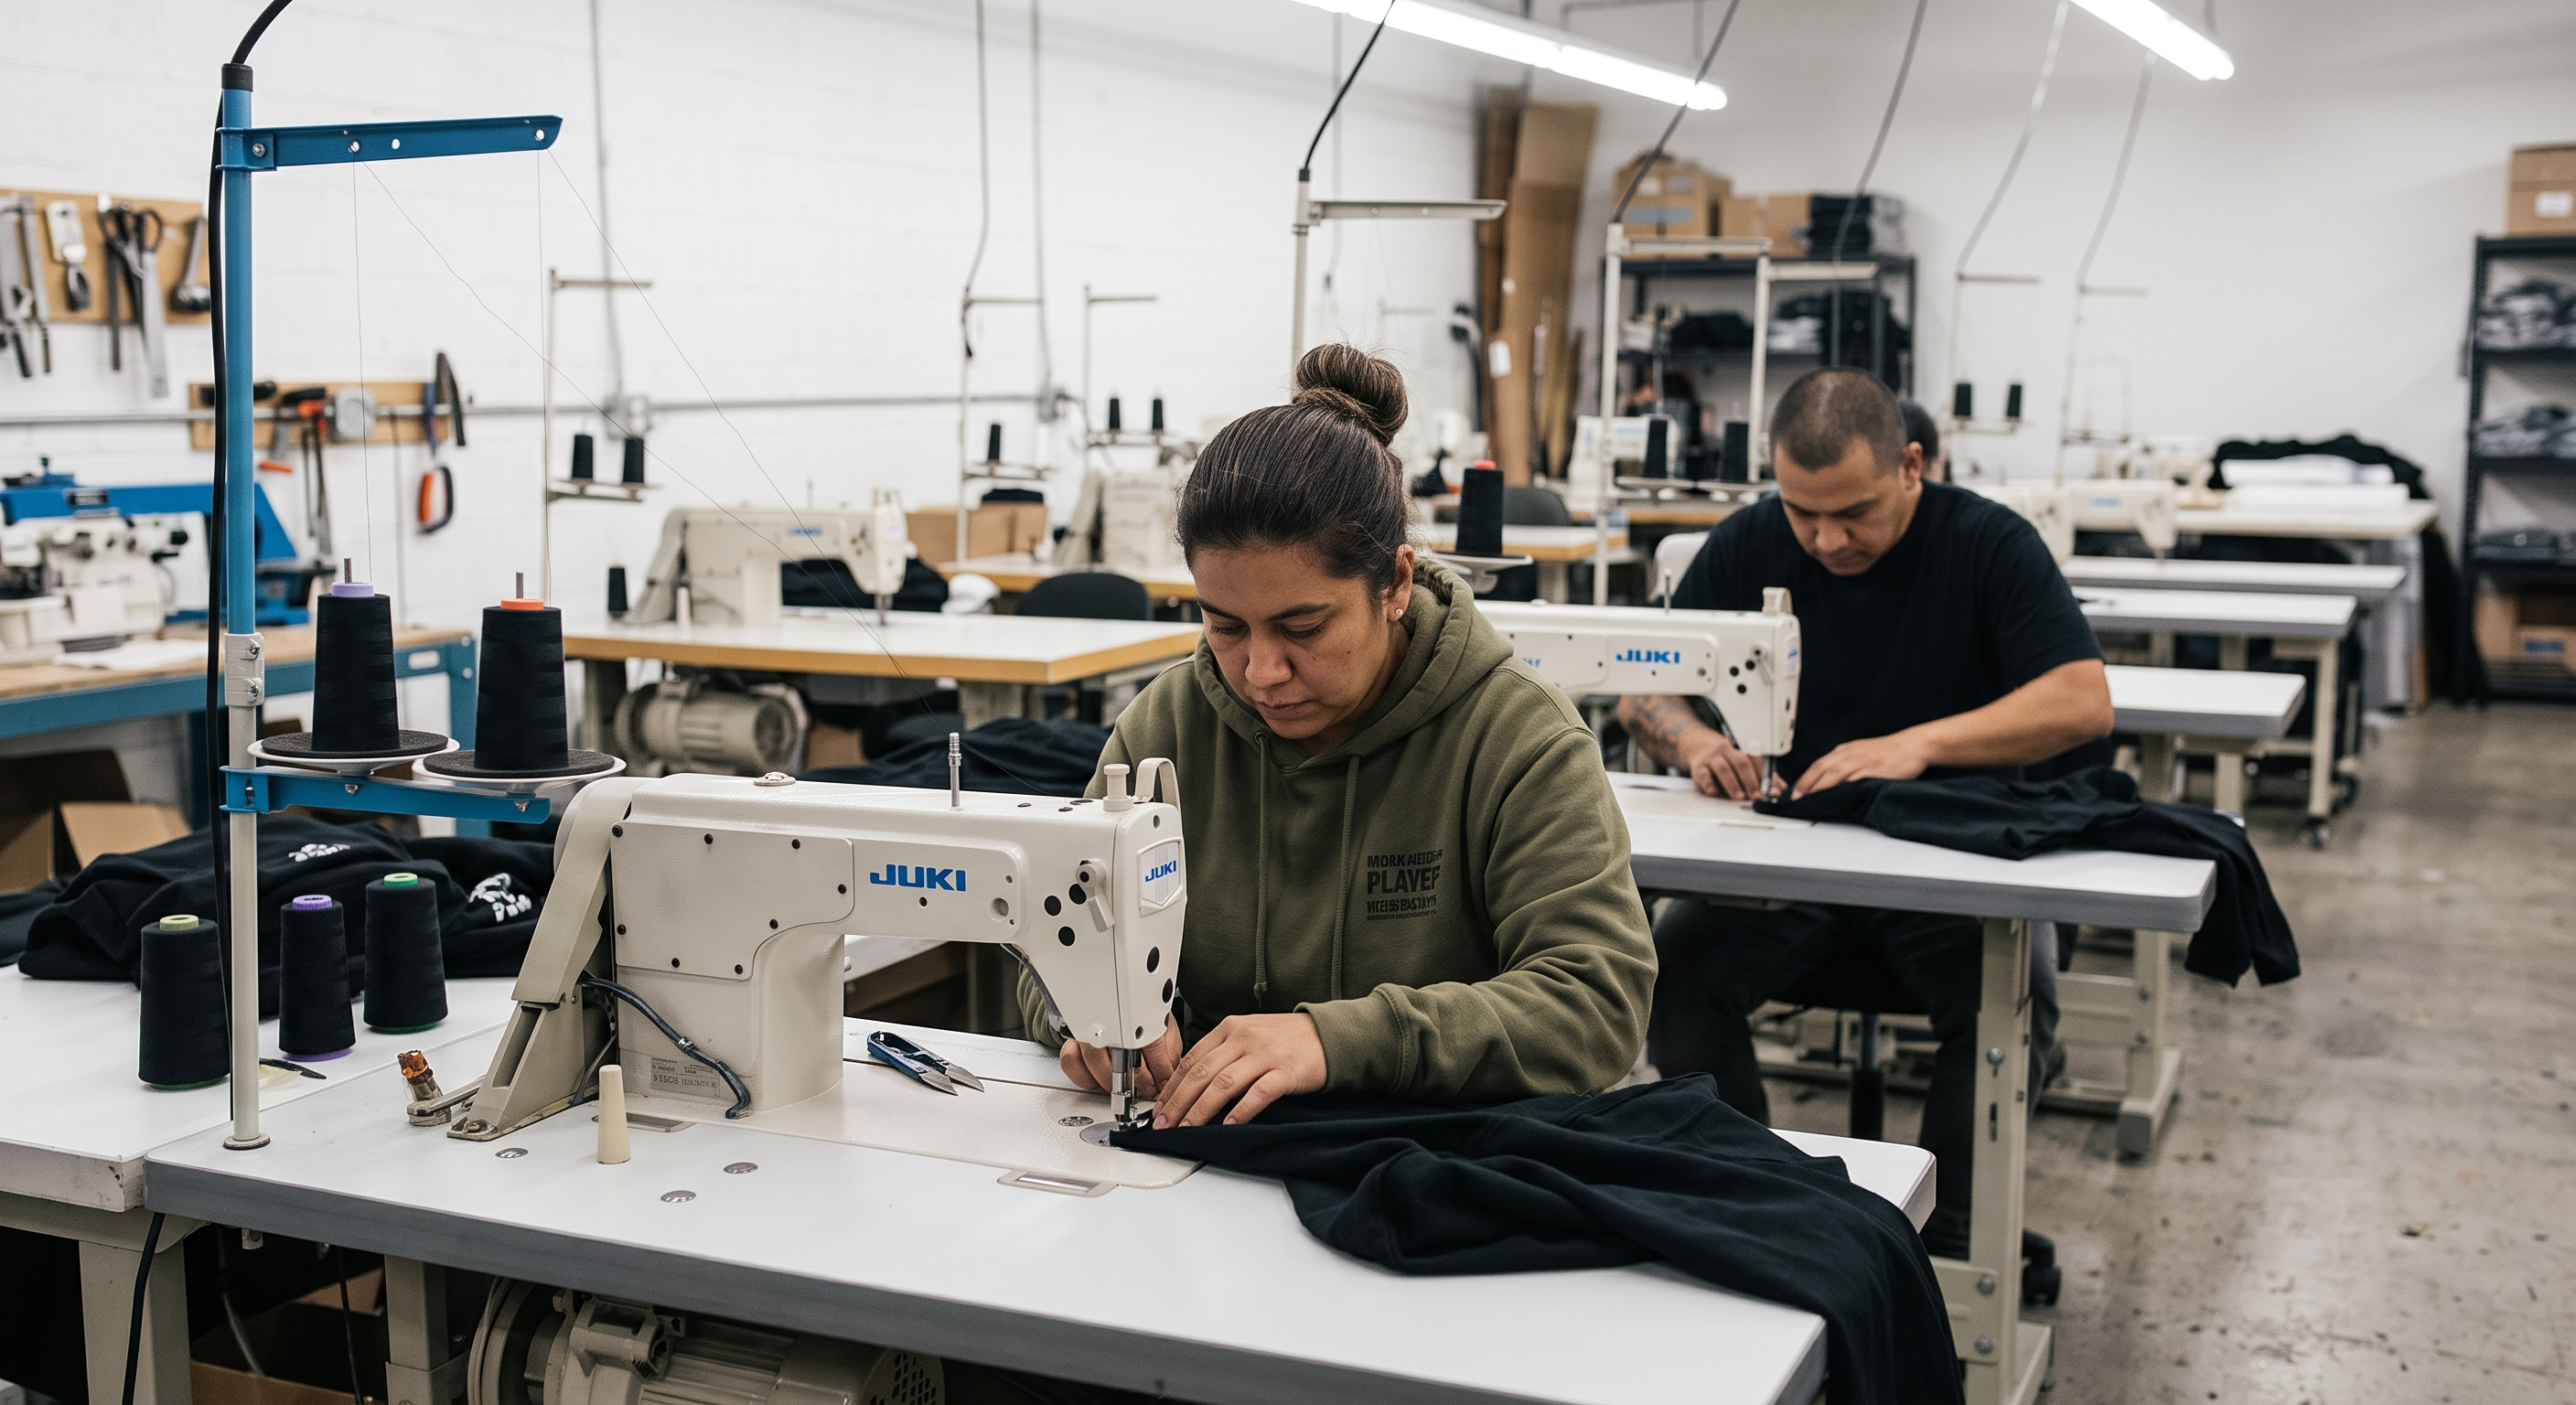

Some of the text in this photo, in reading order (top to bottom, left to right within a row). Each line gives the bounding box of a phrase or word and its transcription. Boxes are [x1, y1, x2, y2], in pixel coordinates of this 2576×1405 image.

[1615, 649, 1680, 664] JUKI
[869, 863, 967, 892] JUKI
[1145, 860, 1177, 883] JUKI
